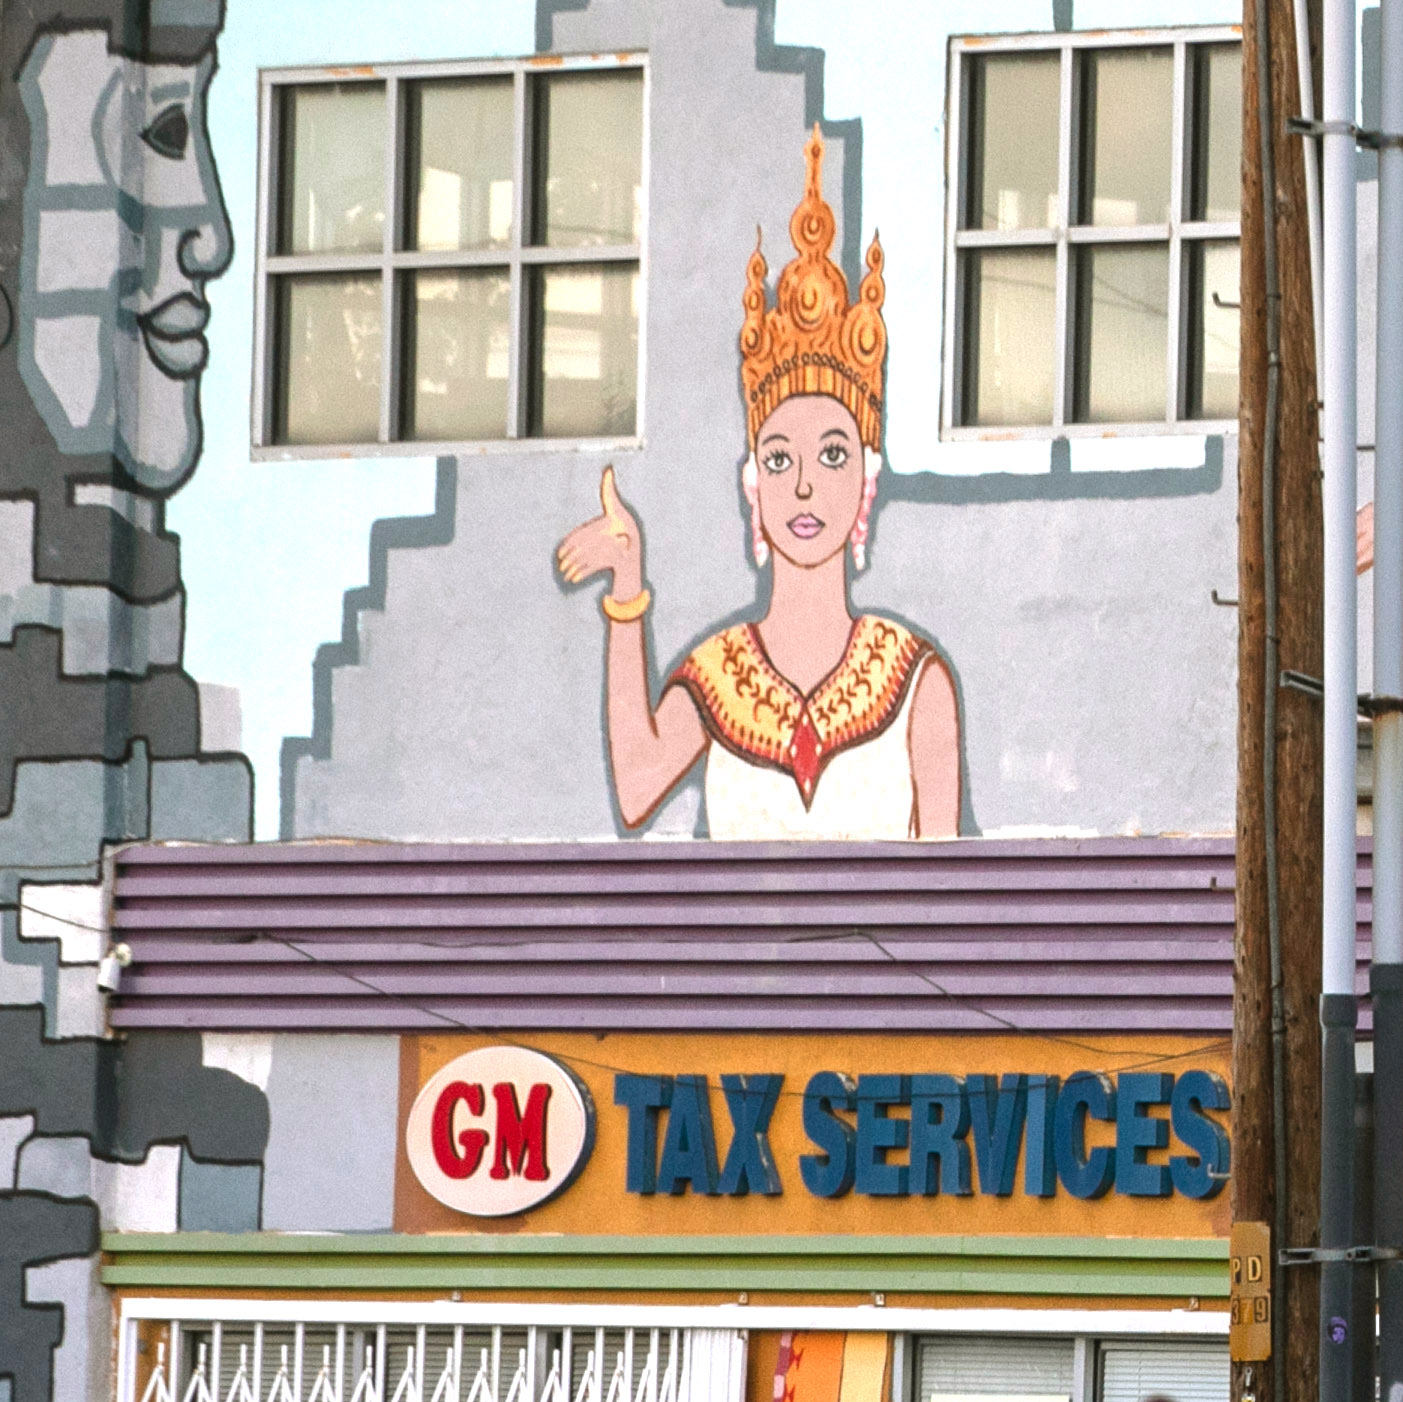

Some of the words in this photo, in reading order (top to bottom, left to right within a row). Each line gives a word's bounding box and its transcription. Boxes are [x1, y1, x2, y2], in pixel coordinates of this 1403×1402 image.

[432, 1081, 553, 1181] GM
[613, 1073, 785, 1196] TAX
[801, 1070, 1232, 1200] SERVICES
